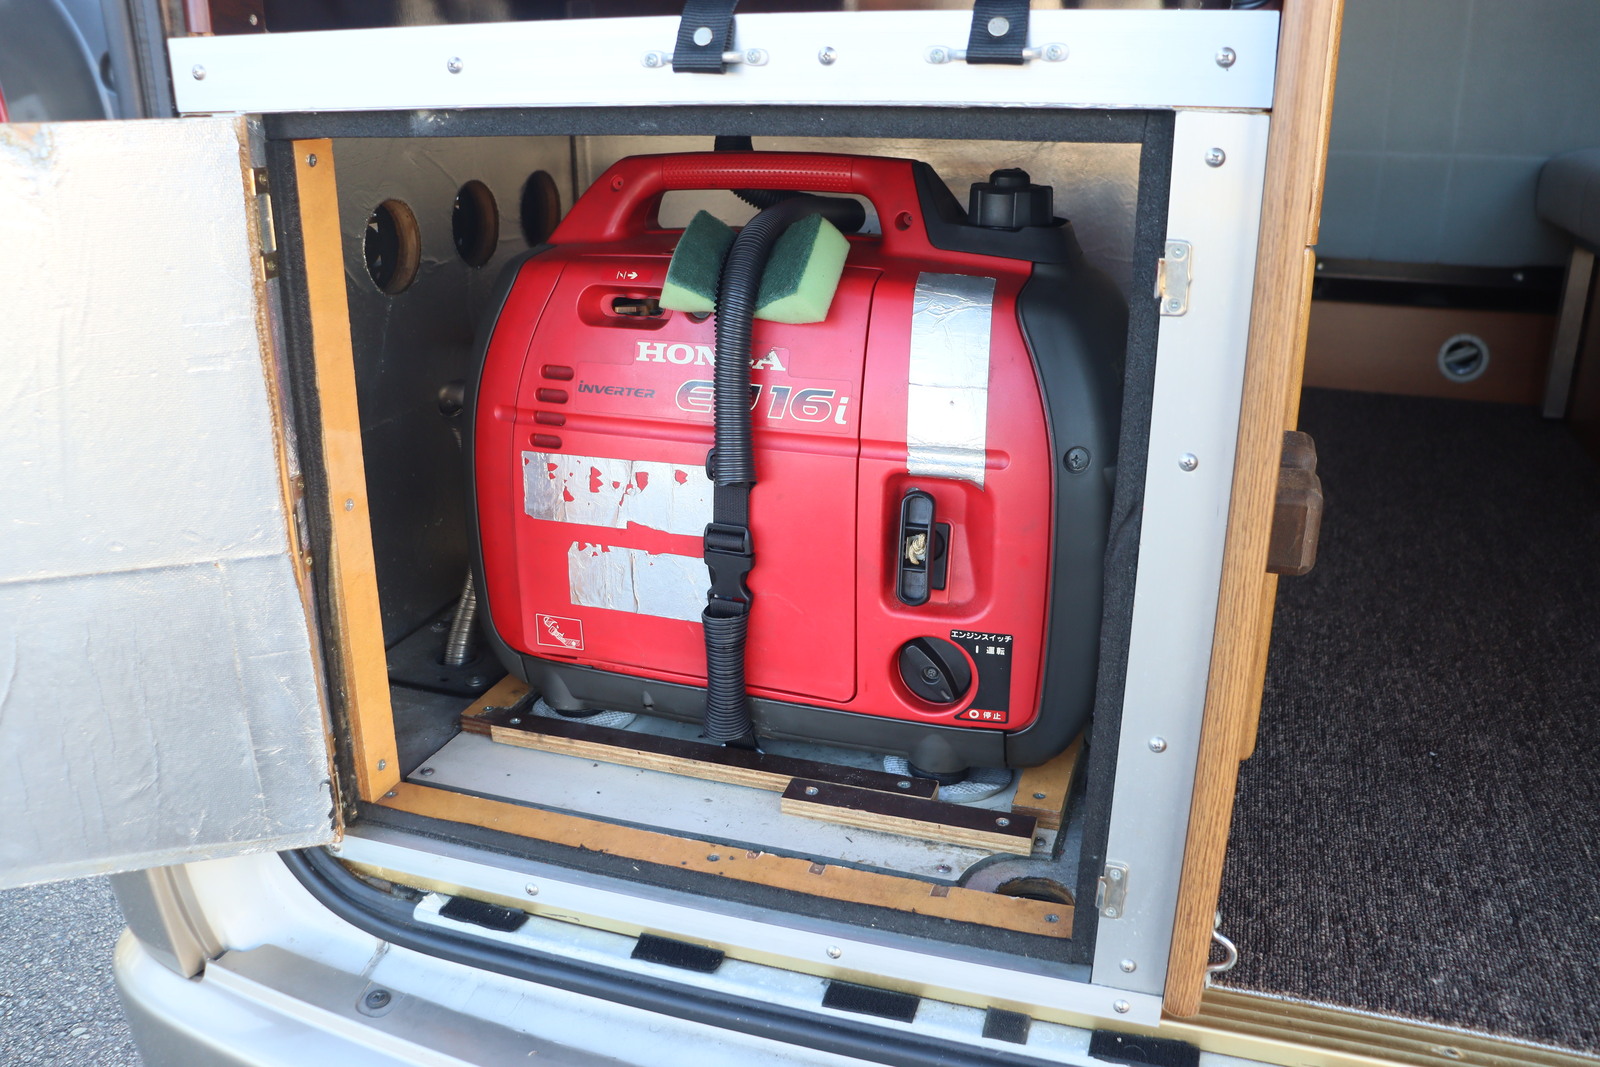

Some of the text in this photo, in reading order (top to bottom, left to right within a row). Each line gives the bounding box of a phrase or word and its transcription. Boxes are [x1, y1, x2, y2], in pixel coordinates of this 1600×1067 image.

[636, 342, 786, 371] HONA
[951, 631, 1012, 642] エンジンスイッチ
[986, 646, 1005, 655] 運転
[983, 711, 1001, 720] 停止
